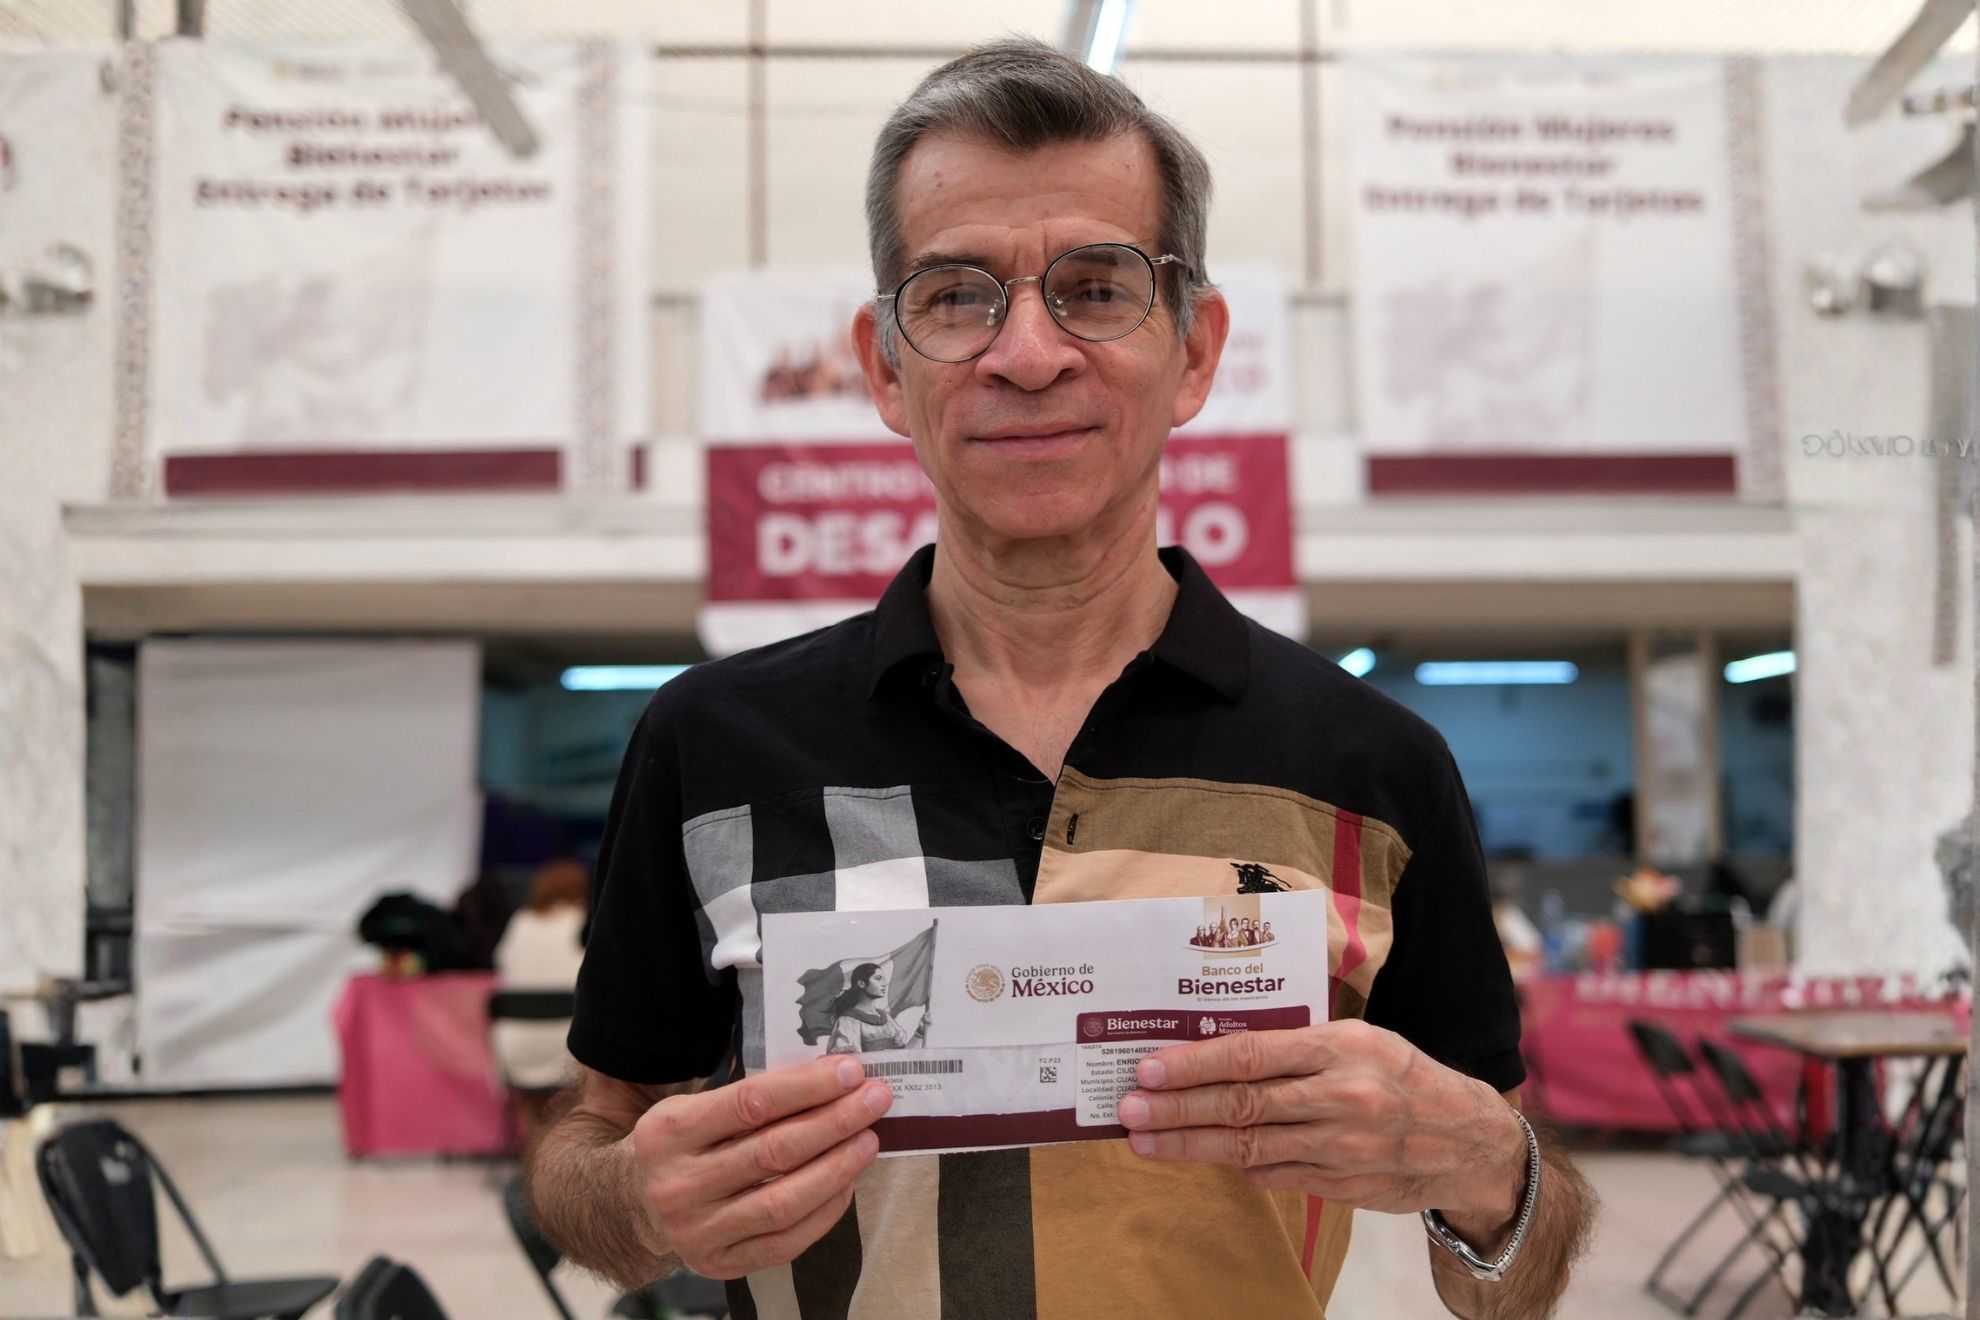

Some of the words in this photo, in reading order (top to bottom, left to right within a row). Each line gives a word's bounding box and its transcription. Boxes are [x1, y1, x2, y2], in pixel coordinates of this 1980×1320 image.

[380, 106, 480, 131] Muje
[1532, 114, 1676, 144] Mujeres
[287, 143, 459, 168] Bienestar
[1449, 152, 1614, 178] Bienestar
[196, 179, 334, 214] Entrega
[351, 179, 389, 203] de
[404, 178, 553, 211] Tarjetas
[1364, 187, 1497, 219] Entrega
[1515, 187, 1549, 212] de
[1563, 187, 1706, 219] Tarjetas
[1011, 965, 1075, 979] Gobierno
[1079, 963, 1094, 975] de
[1202, 965, 1241, 977] Banco
[1245, 962, 1264, 974] del
[1011, 977, 1094, 998] México
[1178, 976, 1285, 995] Bienestar
[1107, 1016, 1179, 1030] Bienestar
[1080, 1078, 1115, 1086] Municipio:
